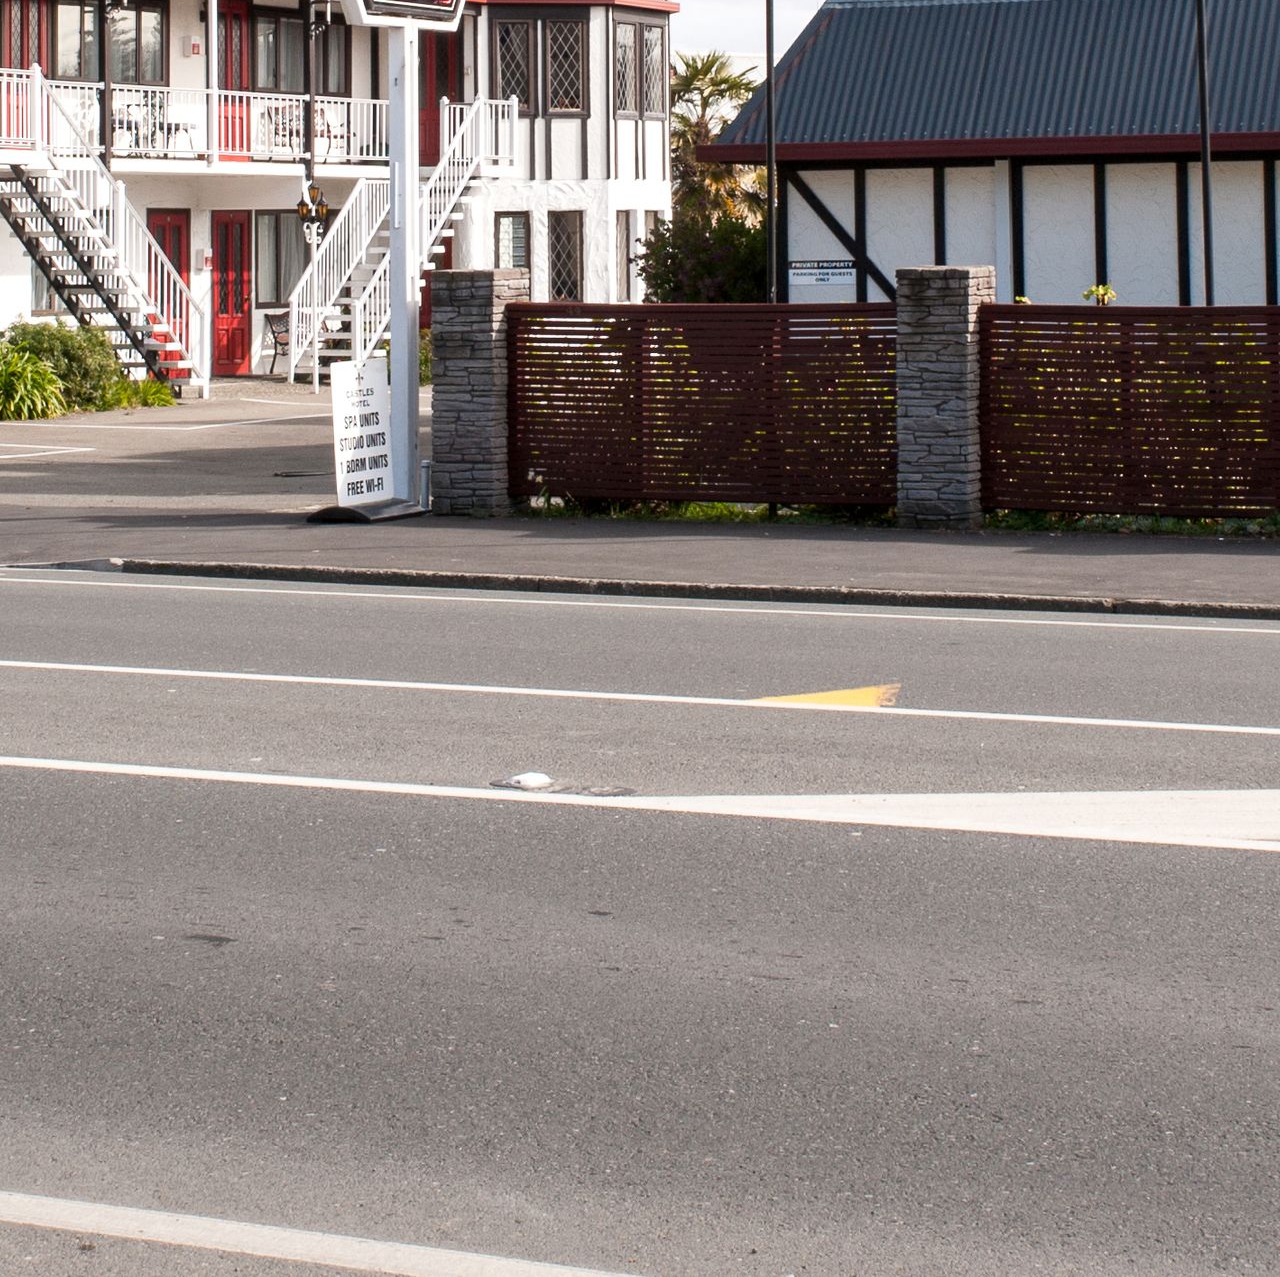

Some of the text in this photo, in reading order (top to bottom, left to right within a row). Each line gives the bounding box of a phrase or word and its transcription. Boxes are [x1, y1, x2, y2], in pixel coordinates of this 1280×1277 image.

[345, 387, 375, 399] CASTLES
[344, 412, 380, 430] SPA UNITS
[339, 432, 386, 452] STUDIO UNITS
[340, 454, 389, 475] 1 BDRM UNITS
[347, 477, 384, 497] FREE WI-FI
